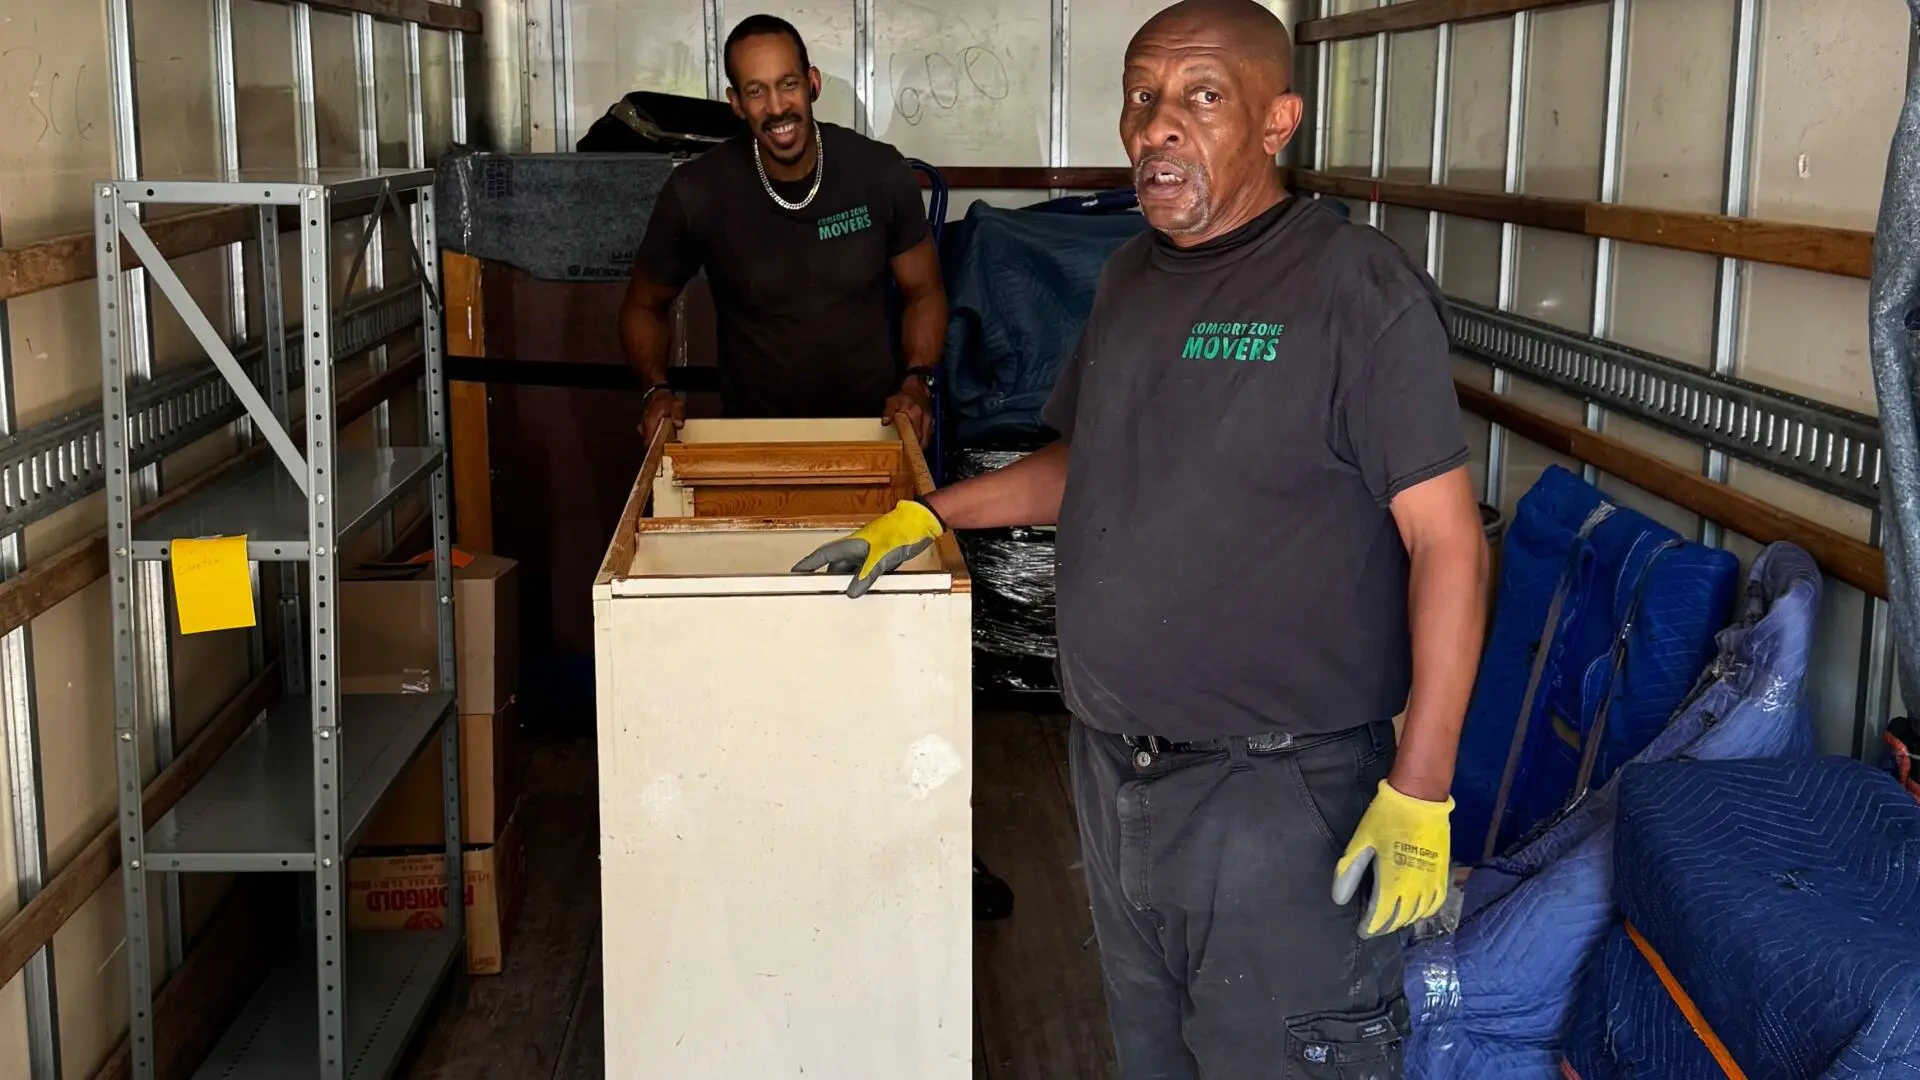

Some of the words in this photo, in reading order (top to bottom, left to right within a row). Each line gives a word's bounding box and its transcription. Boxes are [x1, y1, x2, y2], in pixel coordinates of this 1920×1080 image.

[819, 214, 872, 240] MOVERS
[1191, 322, 1248, 335] COMFORT
[1248, 322, 1284, 335] ZONE
[1182, 336, 1279, 361] MOVERS
[1394, 841, 1418, 855] FIRM
[366, 884, 474, 912] FORIGOLD
